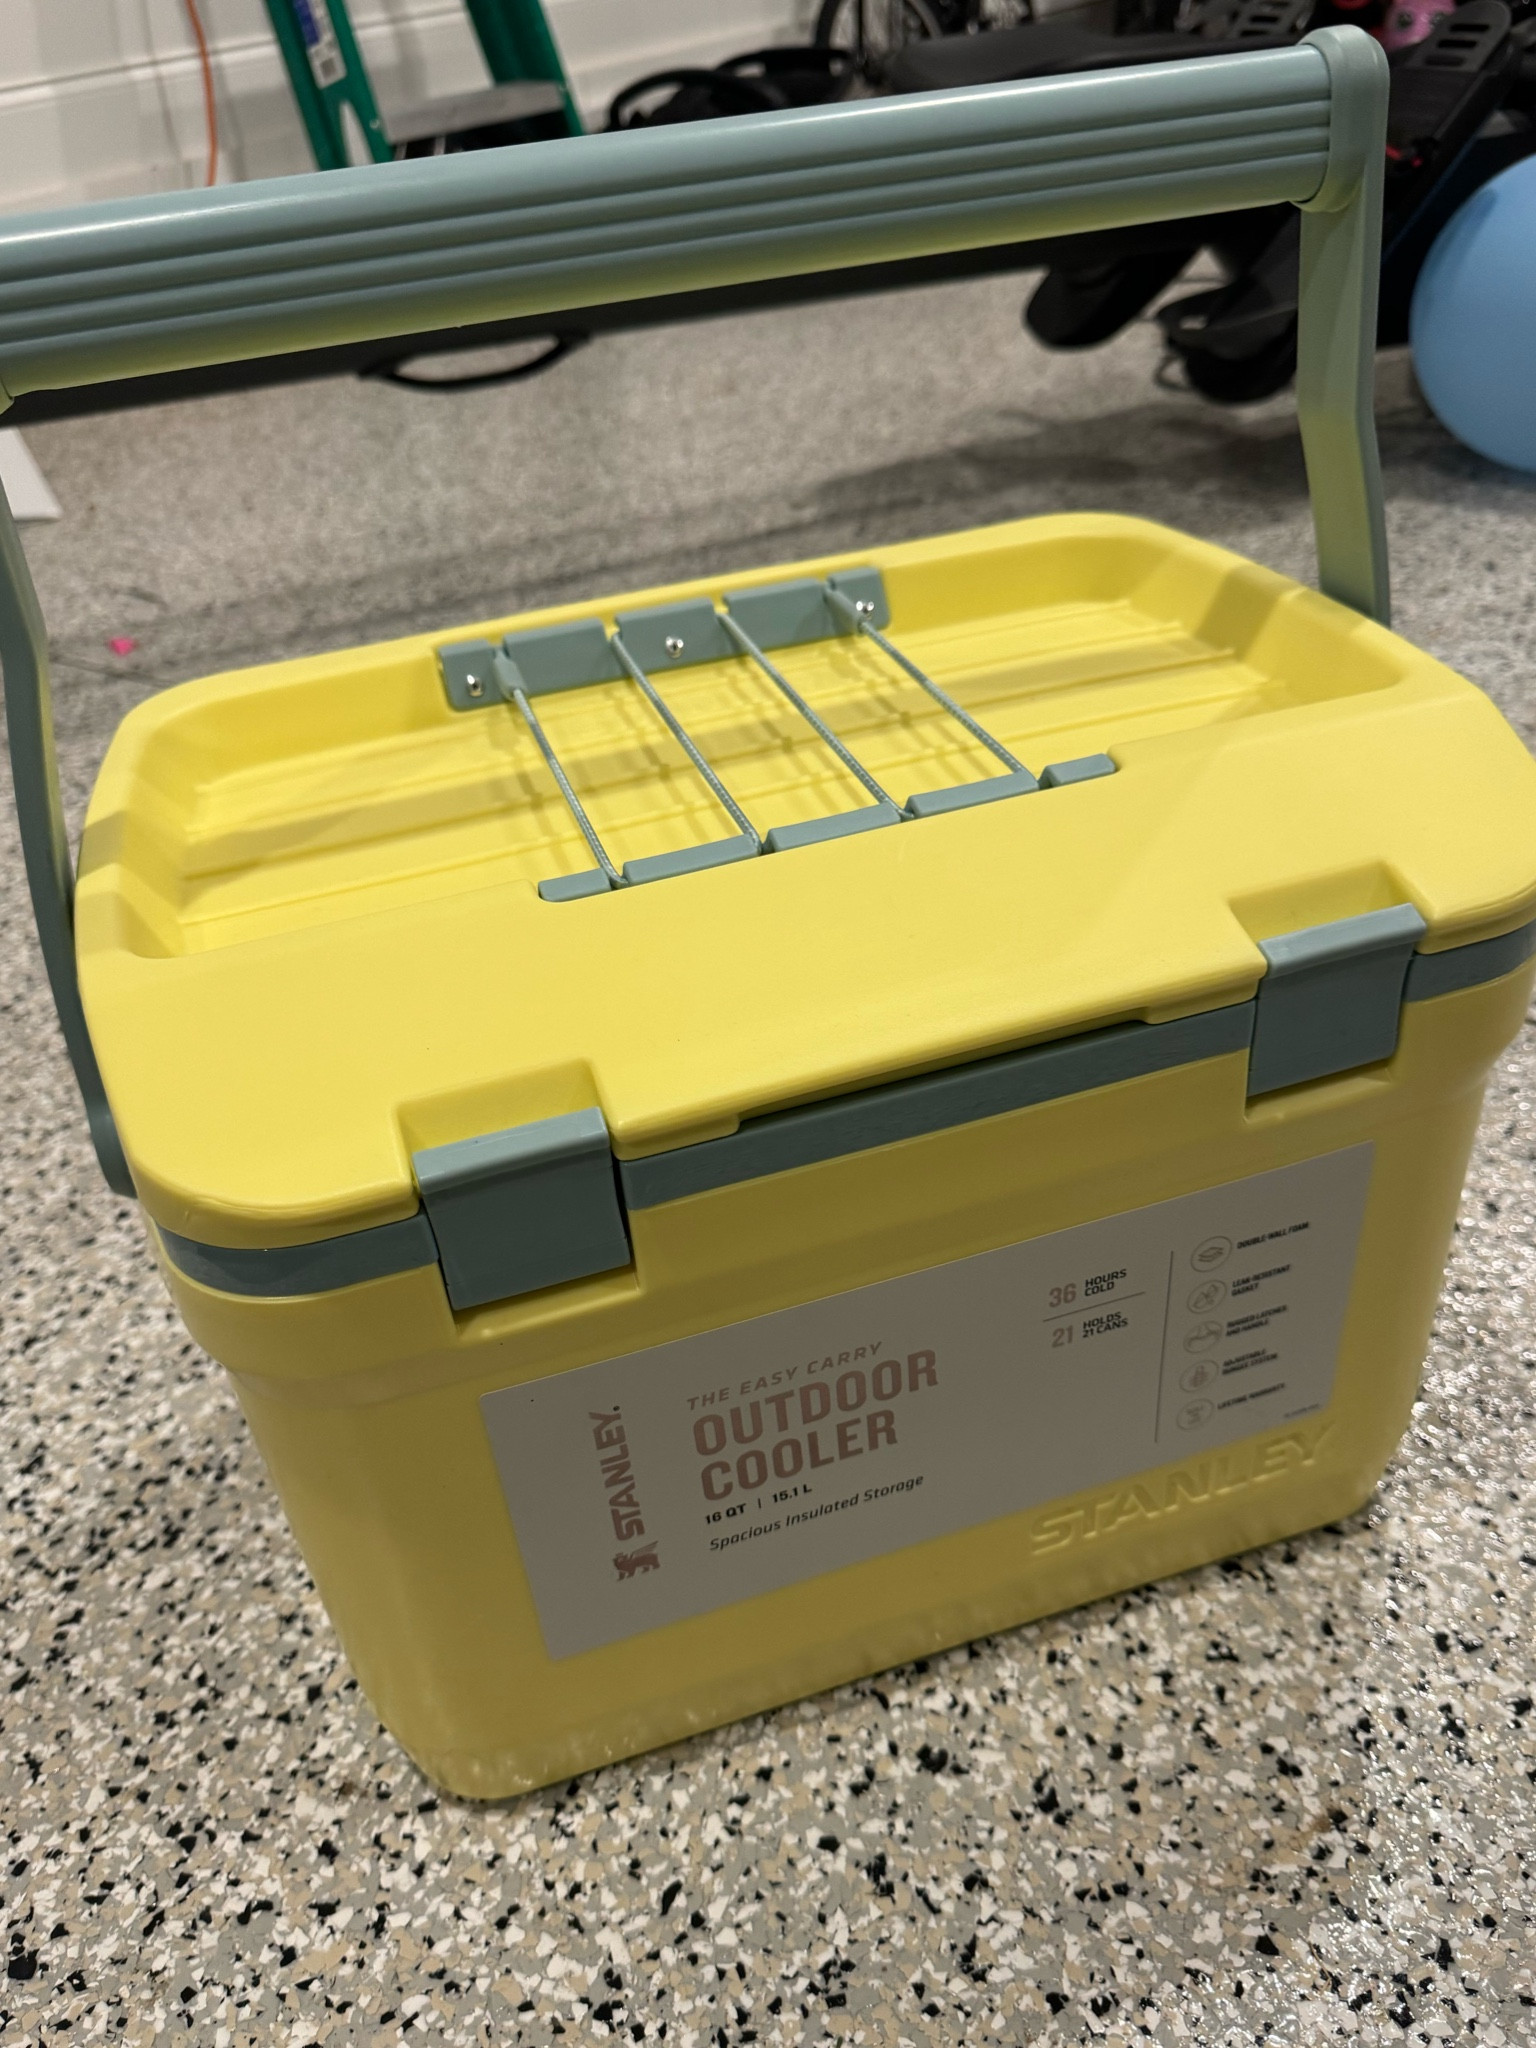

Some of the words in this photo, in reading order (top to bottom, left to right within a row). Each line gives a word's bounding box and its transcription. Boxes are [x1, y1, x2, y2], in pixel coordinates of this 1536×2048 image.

[1084, 1281, 1115, 1297] COLD
[1085, 1268, 1127, 1289] HOURS
[1049, 1283, 1077, 1308] 36
[1051, 1325, 1074, 1348] 21
[1083, 1311, 1122, 1331] HOLDS
[1083, 1325, 1095, 1338] 21
[1096, 1317, 1128, 1334] CANS
[686, 1387, 730, 1411] THE
[739, 1366, 799, 1397] EASY
[806, 1341, 883, 1375] CARRY
[692, 1348, 939, 1457] OUTDOOR
[699, 1409, 898, 1502] COOLER
[704, 1510, 722, 1525] 16
[725, 1502, 748, 1518] QT
[771, 1486, 800, 1504] 15.1
[802, 1483, 813, 1495] L
[1030, 1421, 1336, 1556] STANLEY
[709, 1517, 782, 1552] Spacious
[785, 1493, 860, 1527] Insulated
[863, 1474, 925, 1503] Storage
